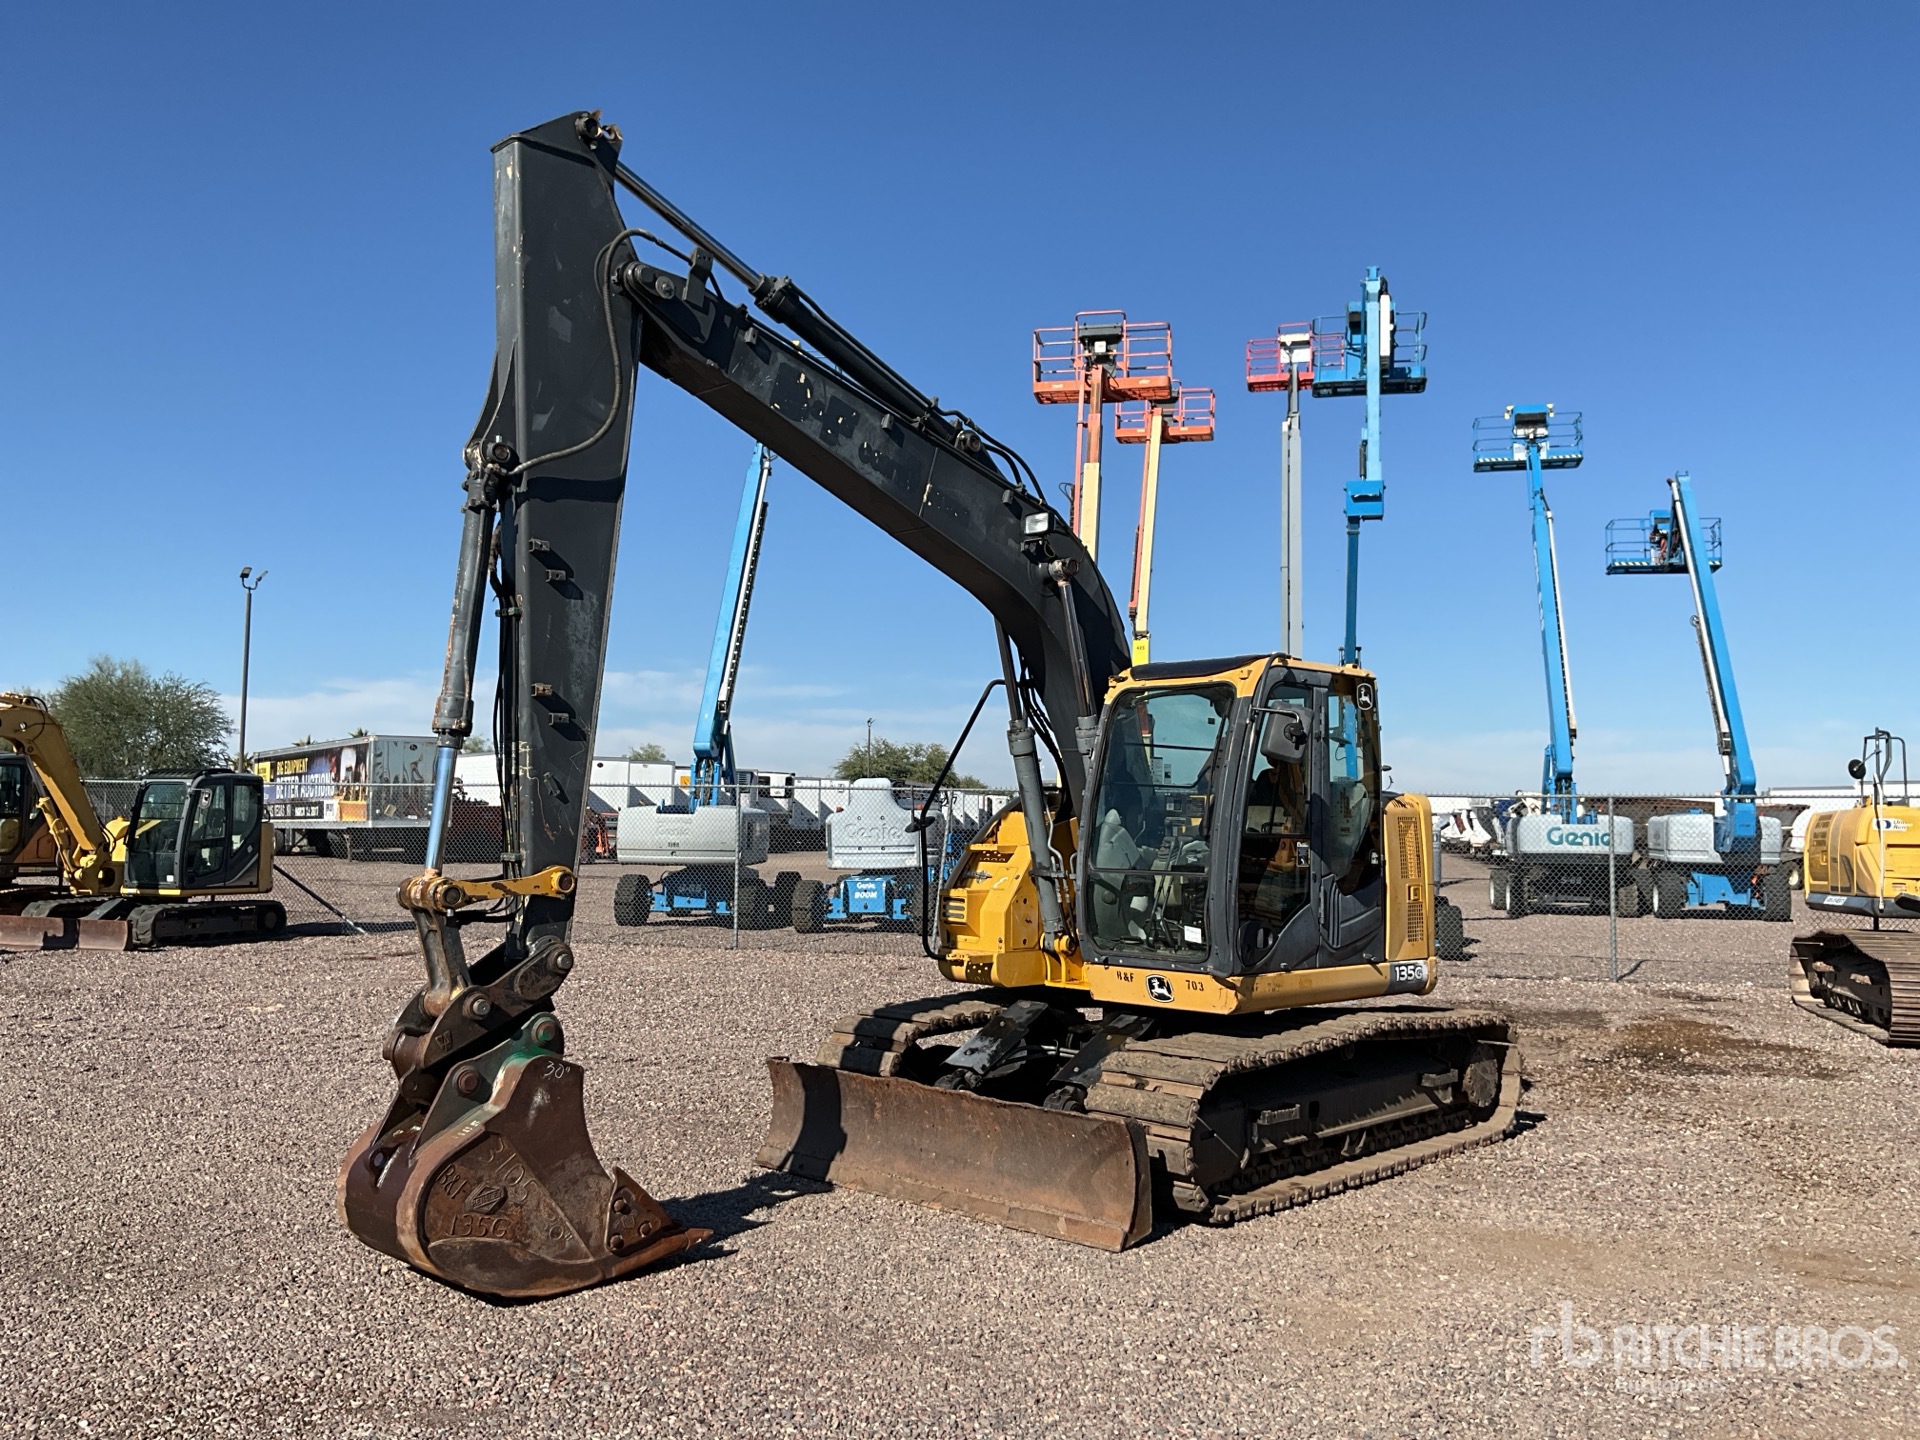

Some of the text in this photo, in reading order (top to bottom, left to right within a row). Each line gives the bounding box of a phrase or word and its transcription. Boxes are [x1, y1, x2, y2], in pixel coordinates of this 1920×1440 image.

[284, 757, 308, 774] EQUIPMENT
[275, 771, 335, 800] BETTER AUCTIONS
[856, 881, 876, 890] Genie
[854, 891, 878, 899] BOOM
[1395, 965, 1423, 982] 135G
[1185, 979, 1204, 992] 703
[445, 1213, 512, 1238] 135G
